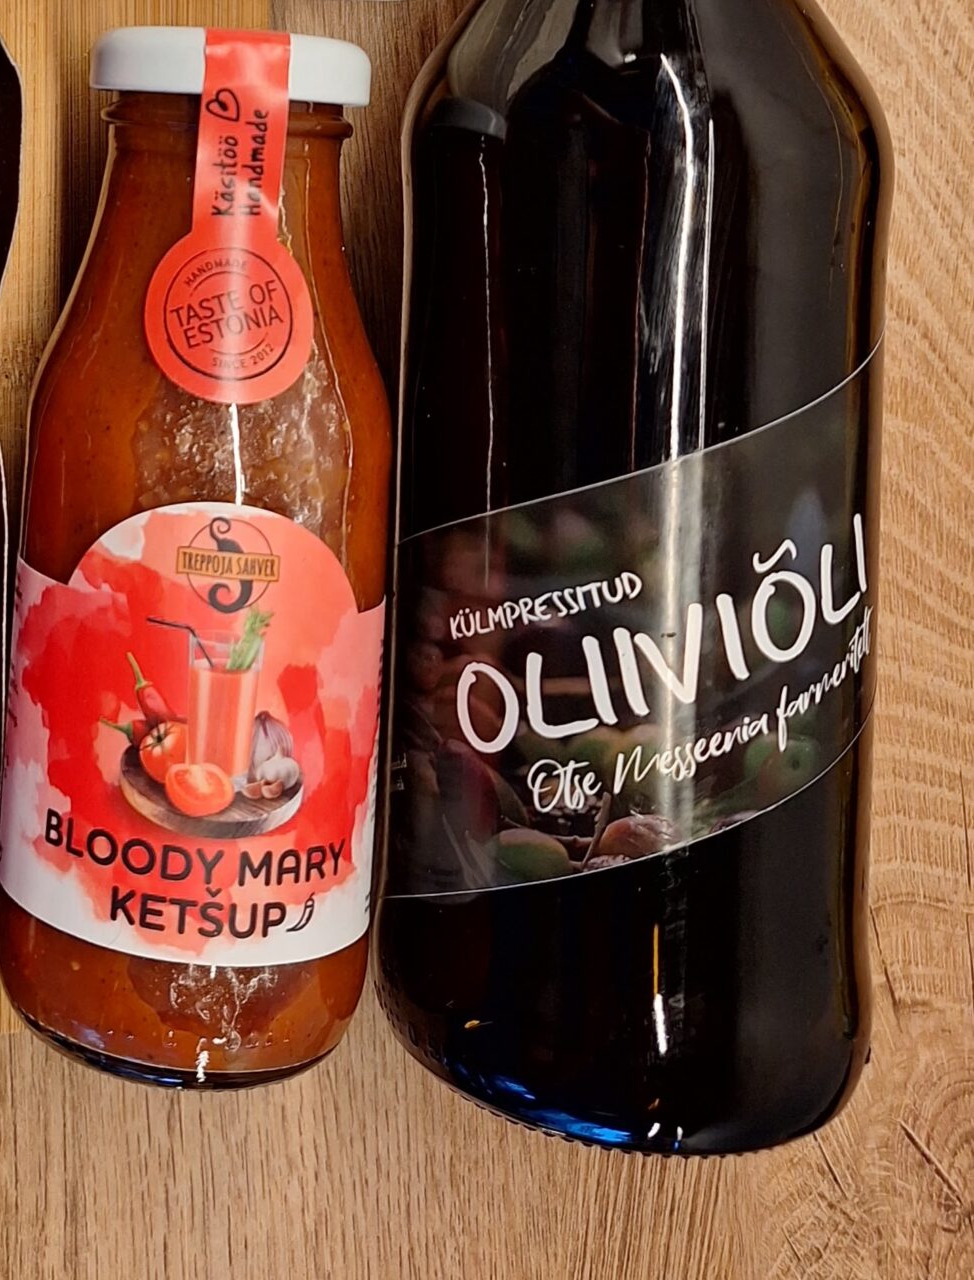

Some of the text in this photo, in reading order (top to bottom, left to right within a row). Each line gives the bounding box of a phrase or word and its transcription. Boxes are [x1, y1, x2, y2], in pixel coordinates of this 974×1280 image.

[210, 135, 239, 216] Käsitöö
[239, 109, 269, 216] Handmade
[184, 257, 247, 287] HANDMADE
[169, 279, 277, 328] TASTE OF
[183, 304, 284, 349] ESTONIA
[211, 356, 249, 369] SINCE
[182, 551, 276, 577] TREPPOJA SAHVER
[449, 571, 643, 641] KÜLMPRESSITUD
[456, 513, 868, 753] OLIIVIÕLI
[527, 758, 603, 813] Otse
[612, 713, 769, 796] Messeenia
[44, 807, 346, 887] BLOODY MARY
[109, 885, 287, 939] KETŠUP
